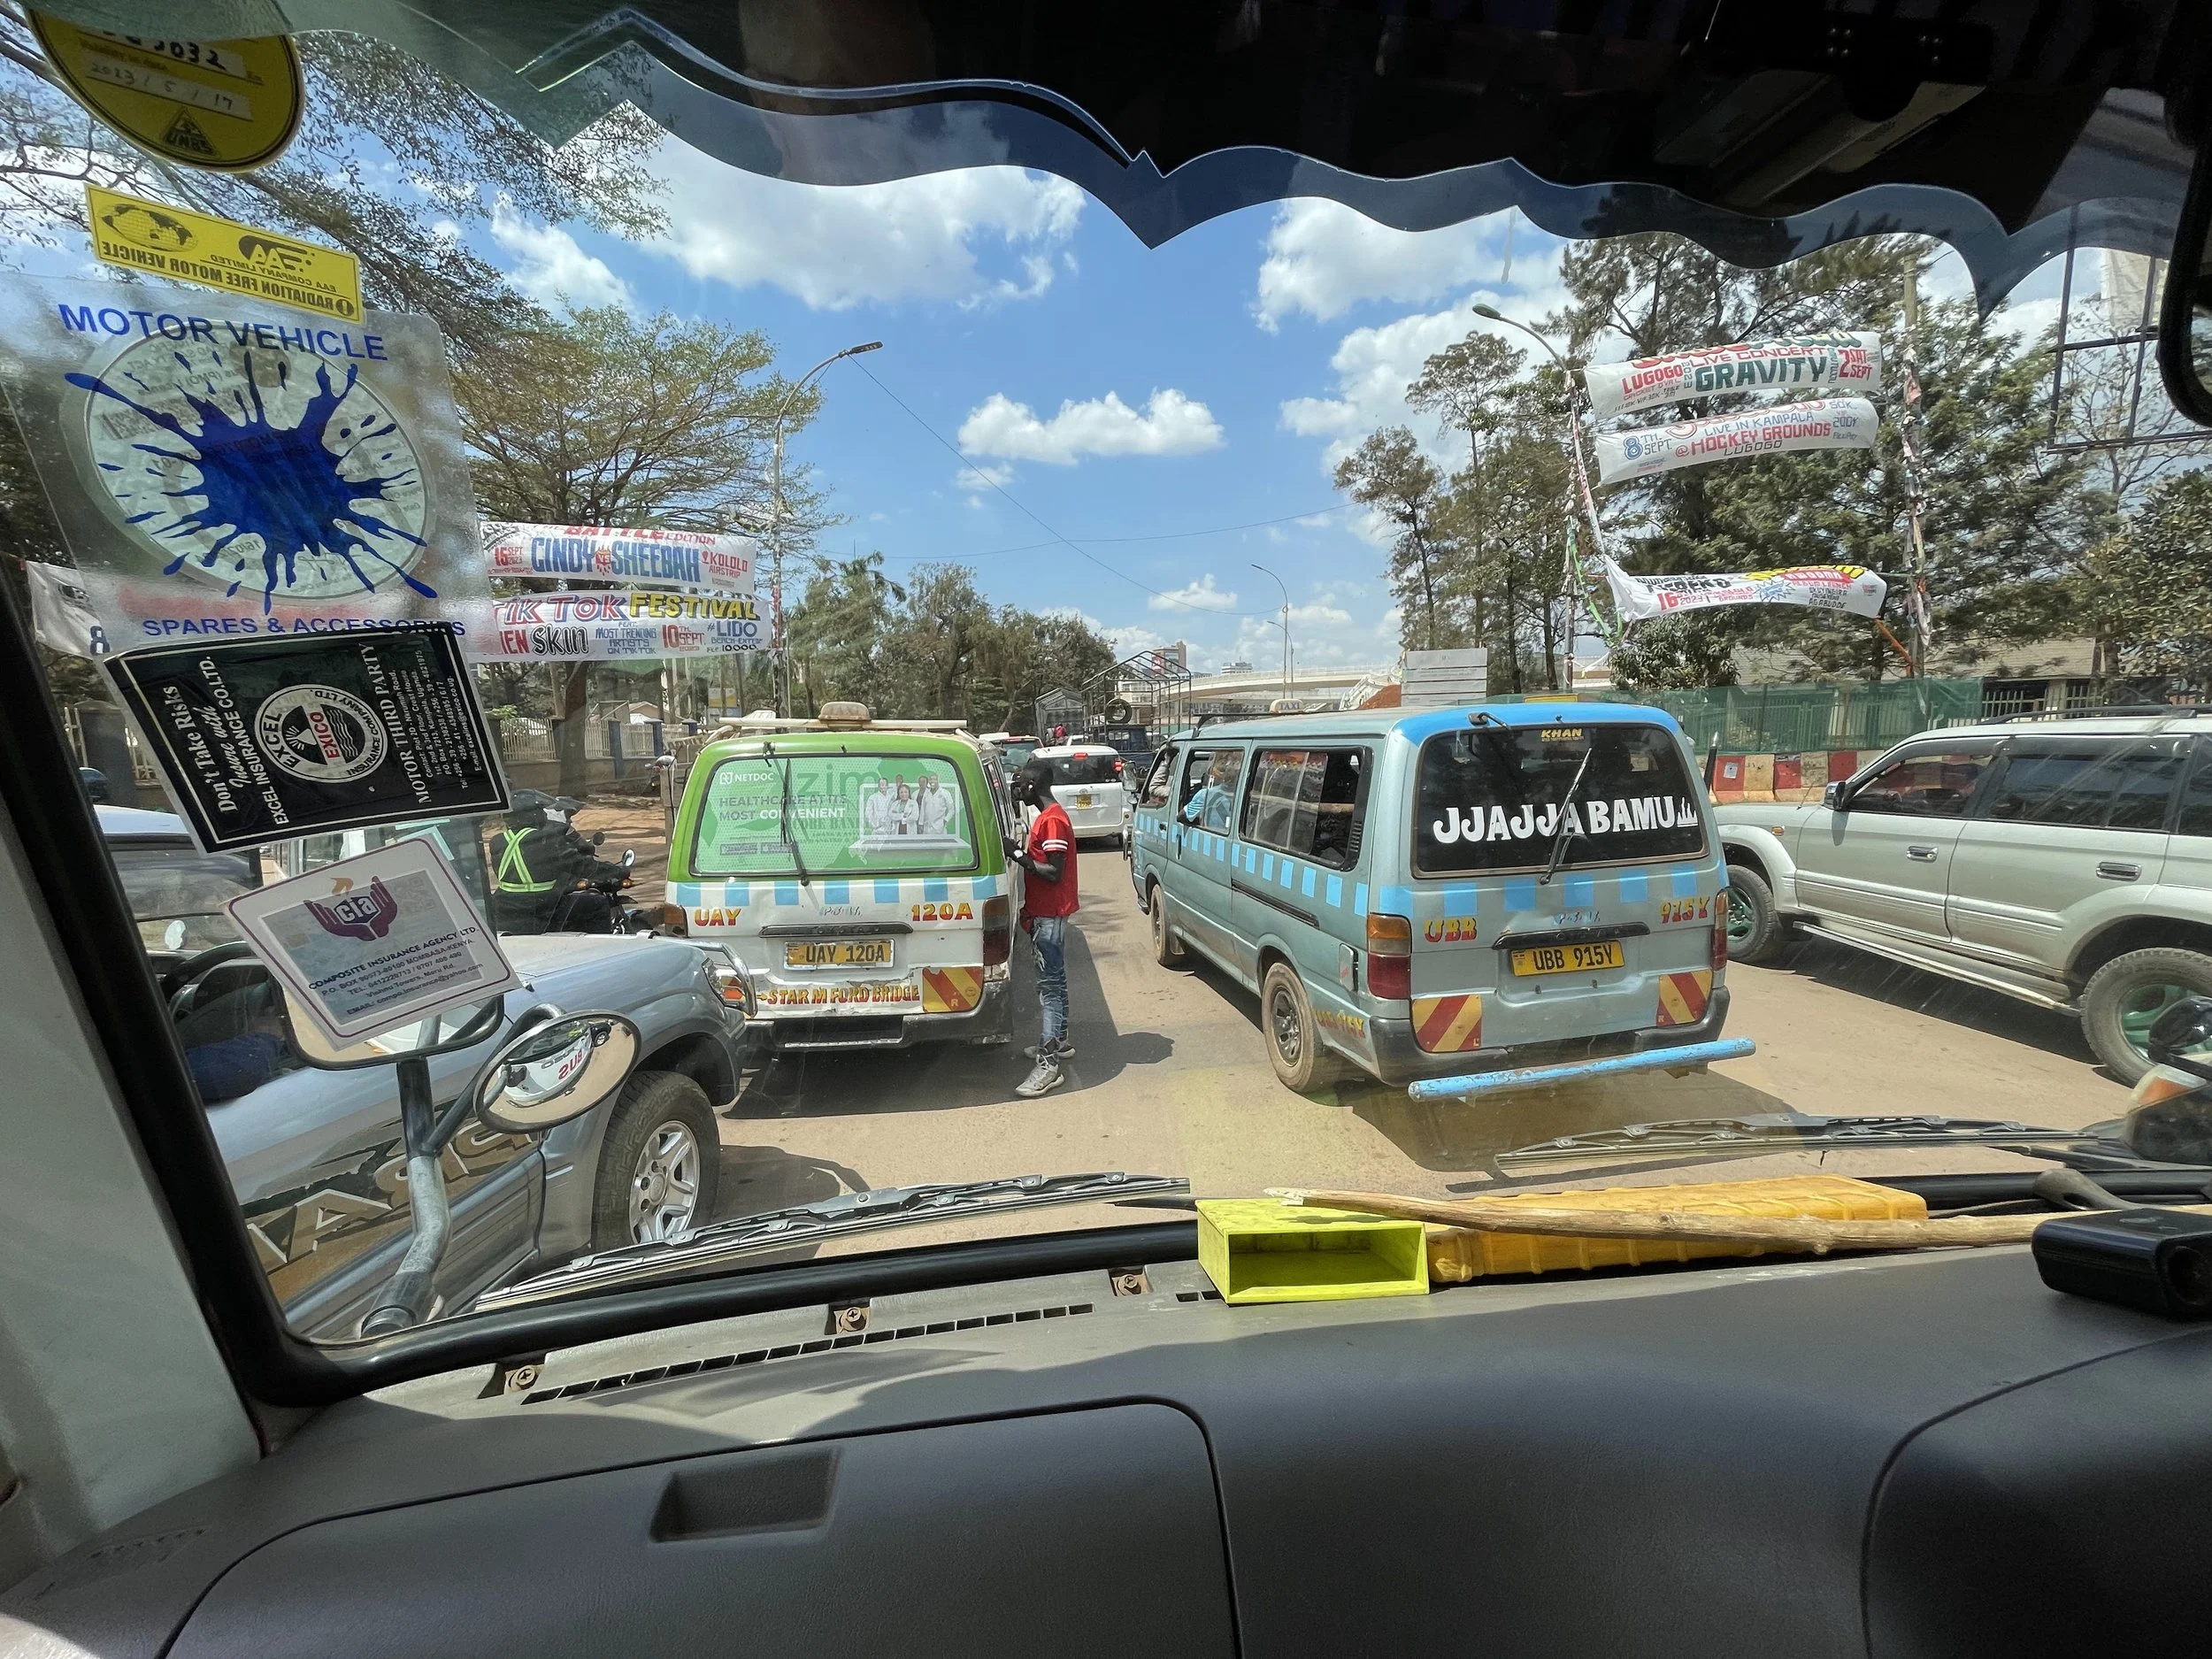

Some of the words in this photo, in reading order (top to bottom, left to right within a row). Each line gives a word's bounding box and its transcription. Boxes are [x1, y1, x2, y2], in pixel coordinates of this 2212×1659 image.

[58, 303, 219, 345] MOTOR
[225, 319, 388, 362] VEHICLE
[1690, 353, 1732, 368] LIVE
[1736, 347, 1827, 360] CONCERT
[1838, 349, 1850, 378] 2
[1848, 349, 1868, 364] SAT
[1621, 365, 1684, 395] LUGOGO
[1694, 356, 1828, 392] GRAVITY
[1704, 422, 1734, 436] LIVE
[1735, 420, 1749, 430] IN
[1752, 411, 1815, 428] KAMPALA
[1762, 422, 1832, 442] GROUNDS
[1623, 435, 1644, 461] 8
[1724, 440, 1784, 456] LUGOGO
[665, 532, 716, 545] EDITION
[532, 537, 596, 572] CINDY
[611, 539, 702, 583] SHEEBAH
[709, 565, 741, 579] AIRSTRIP
[710, 551, 749, 572] KOLOLO
[547, 593, 630, 623] TOK
[629, 592, 762, 621] FESTIVAL
[1656, 591, 1679, 611] 16
[143, 617, 259, 637] SPARES
[267, 617, 284, 634] &
[662, 624, 680, 649] 10
[358, 643, 390, 695] PARTY
[400, 670, 413, 693] House
[163, 686, 196, 730] Risks
[338, 695, 380, 736] COMPANY
[409, 693, 420, 712] Crest
[1280, 702, 1300, 710] TAXI
[193, 705, 228, 739] with
[310, 711, 341, 759] EXICO
[379, 699, 409, 749] THIRD
[1540, 728, 1583, 739] KHAN
[187, 731, 216, 770] Take
[223, 710, 271, 786] INSURANCE
[263, 711, 302, 769] EXCEL
[220, 742, 252, 788] Insure
[346, 736, 381, 776] INSURANCE
[399, 749, 432, 804] MOTOR
[734, 772, 775, 782] NETDOC
[261, 786, 290, 825] EXCEL
[718, 810, 757, 822] MOST
[1586, 795, 1675, 834] BAMU
[694, 908, 741, 928] UAY
[911, 902, 974, 922] 120A
[1661, 895, 1711, 925] 915Y
[1424, 918, 1479, 943] UBB
[308, 964, 367, 989] COMPOSITE
[367, 945, 422, 968] INSURANCE
[423, 932, 457, 949] AGENCY
[805, 945, 837, 964] UAY
[845, 944, 886, 963] 120A
[1533, 949, 1565, 972] UBB
[1573, 944, 1614, 968] 915Y
[767, 989, 810, 1005] STAR
[871, 984, 920, 1003] BRIDGE
